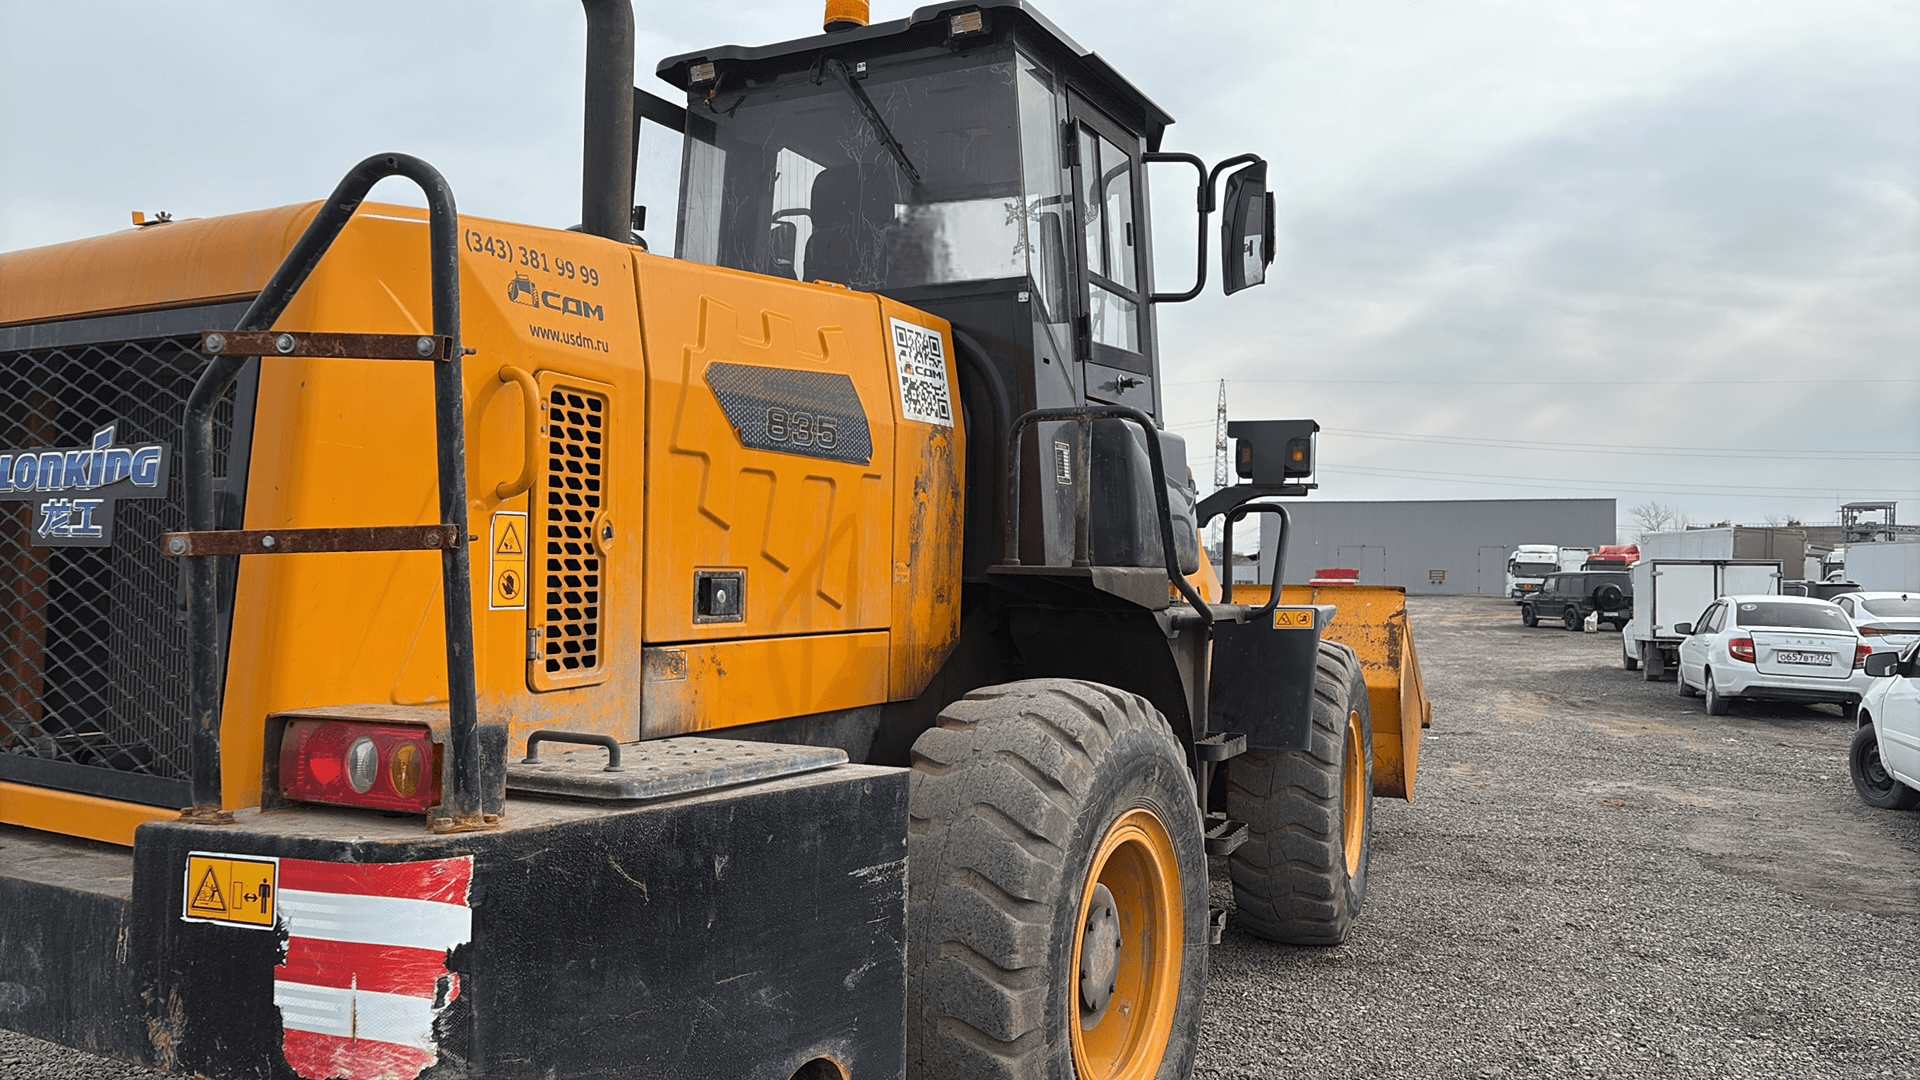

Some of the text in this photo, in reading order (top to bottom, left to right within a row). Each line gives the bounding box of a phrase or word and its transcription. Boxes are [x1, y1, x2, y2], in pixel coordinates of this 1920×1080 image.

[465, 229, 599, 287] (343) 381 99 99
[541, 291, 604, 322] СДМ
[529, 324, 609, 353] www.usdm.ru
[766, 406, 838, 449] 835
[38, 498, 104, 538] 龙工
